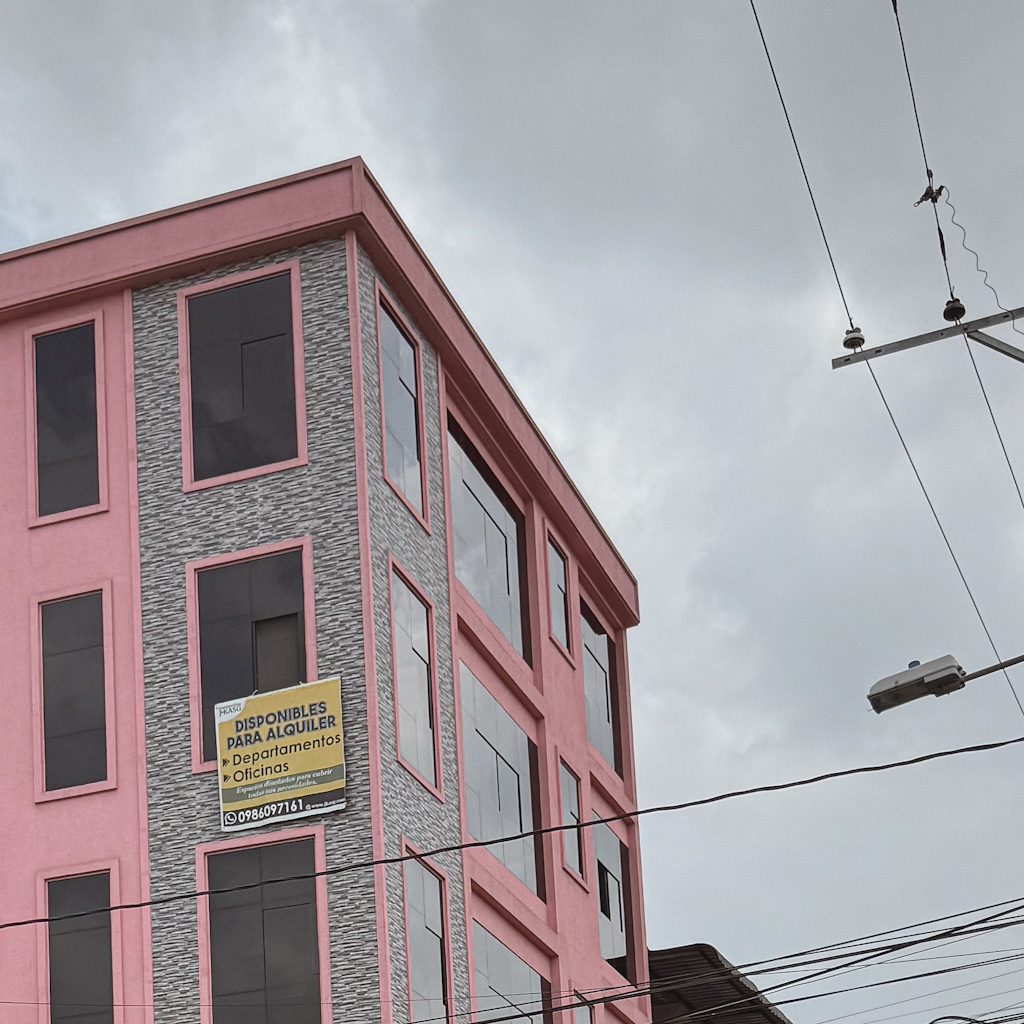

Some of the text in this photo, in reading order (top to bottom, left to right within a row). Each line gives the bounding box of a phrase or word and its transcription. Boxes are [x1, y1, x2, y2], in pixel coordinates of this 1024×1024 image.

[235, 701, 327, 733] DISPONIBLES
[227, 715, 337, 751] PARA ALQUILER
[233, 734, 341, 766] Departamentos
[233, 762, 289, 782] Oficinas
[296, 774, 311, 784] para
[312, 769, 333, 778] cubrir
[238, 799, 304, 823] 0986097161
